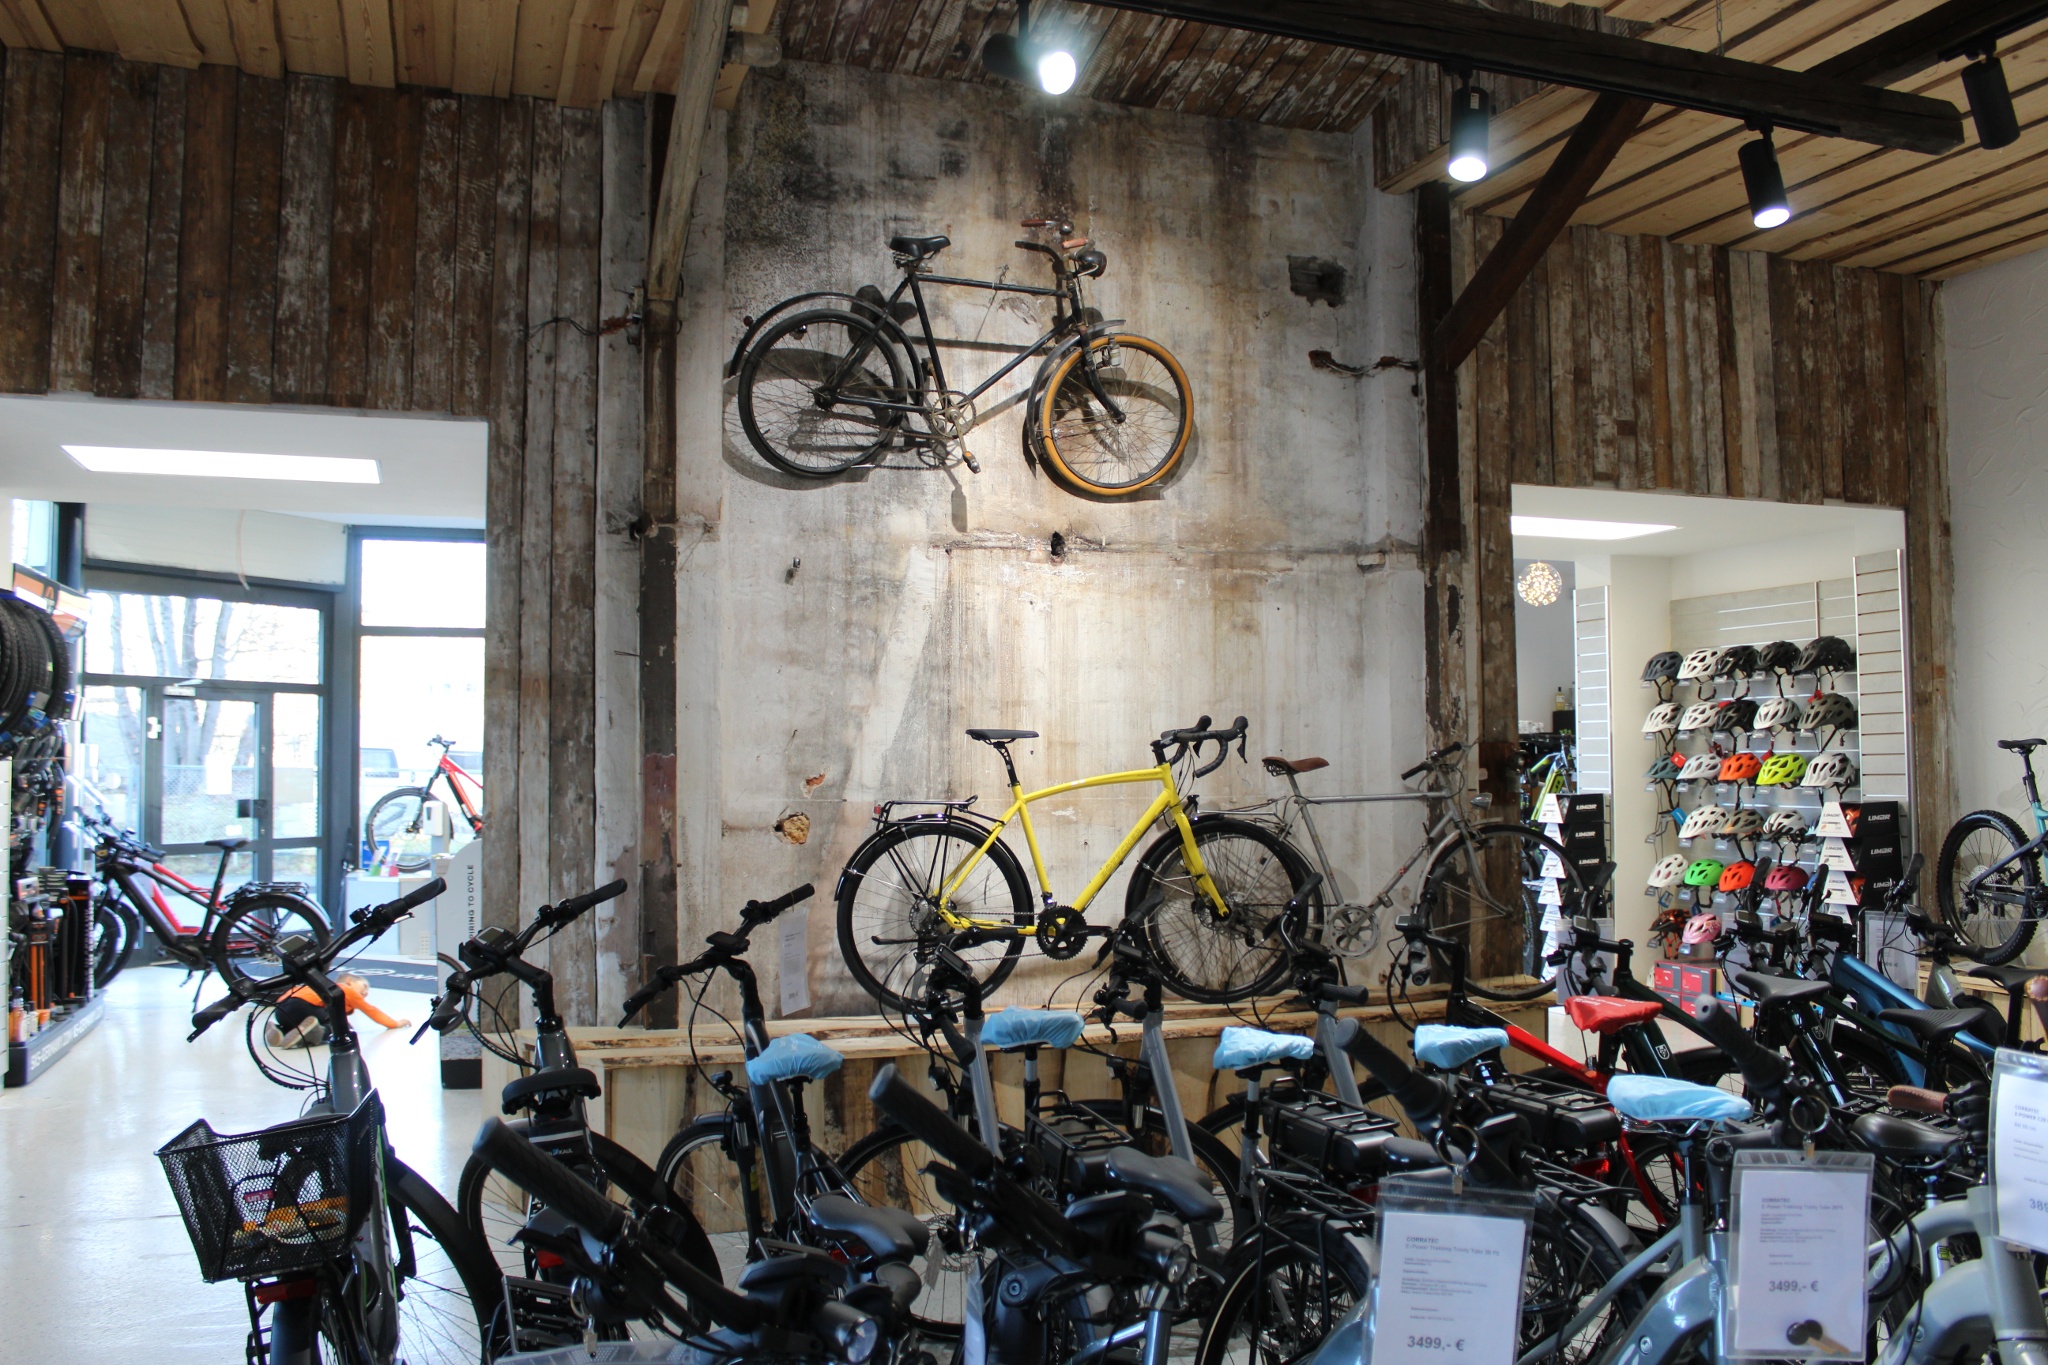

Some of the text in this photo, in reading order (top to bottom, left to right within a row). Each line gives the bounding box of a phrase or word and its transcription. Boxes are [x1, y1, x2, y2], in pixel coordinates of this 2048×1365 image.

[468, 895, 475, 907] TO
[1769, 1280, 1819, 1293] 3499,- €
[1407, 1335, 1465, 1352] 3499,- €
